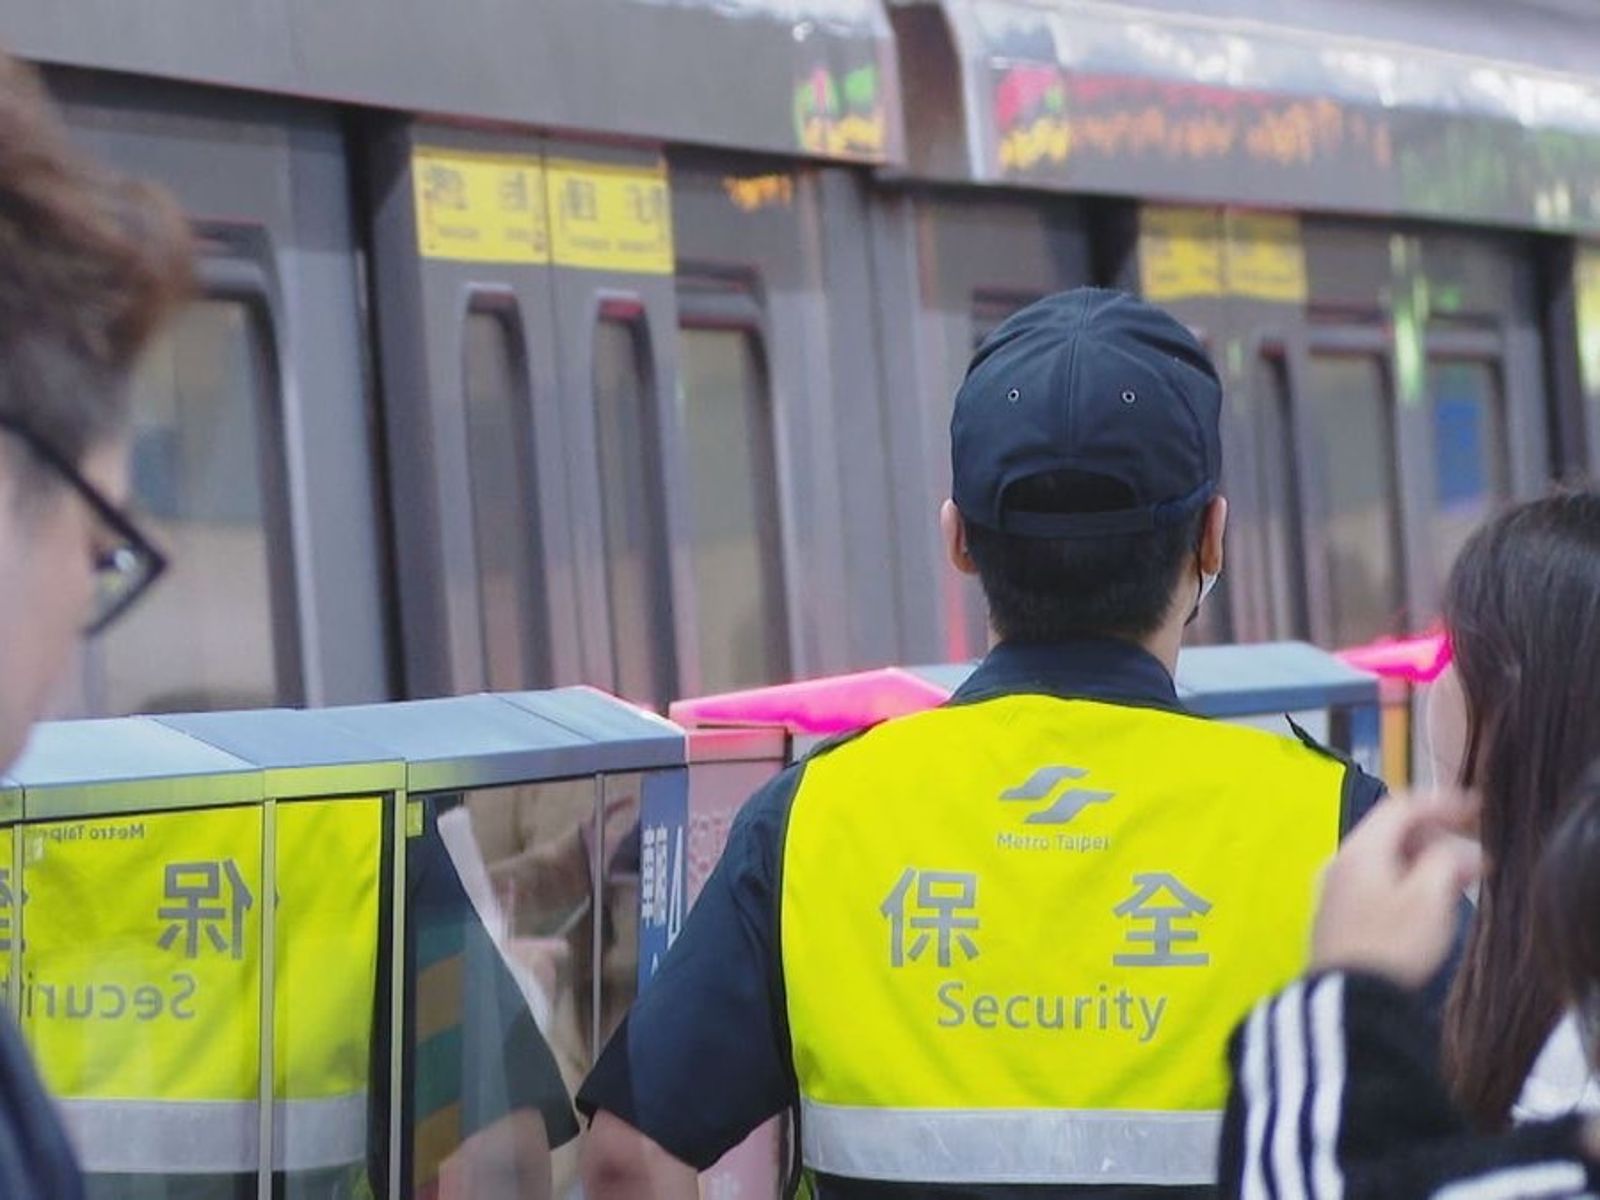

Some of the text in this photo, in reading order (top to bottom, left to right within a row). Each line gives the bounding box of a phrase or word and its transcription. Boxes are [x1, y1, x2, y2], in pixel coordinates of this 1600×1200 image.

[996, 832, 1109, 853] Metro Taipei
[937, 981, 1168, 1042] Security
